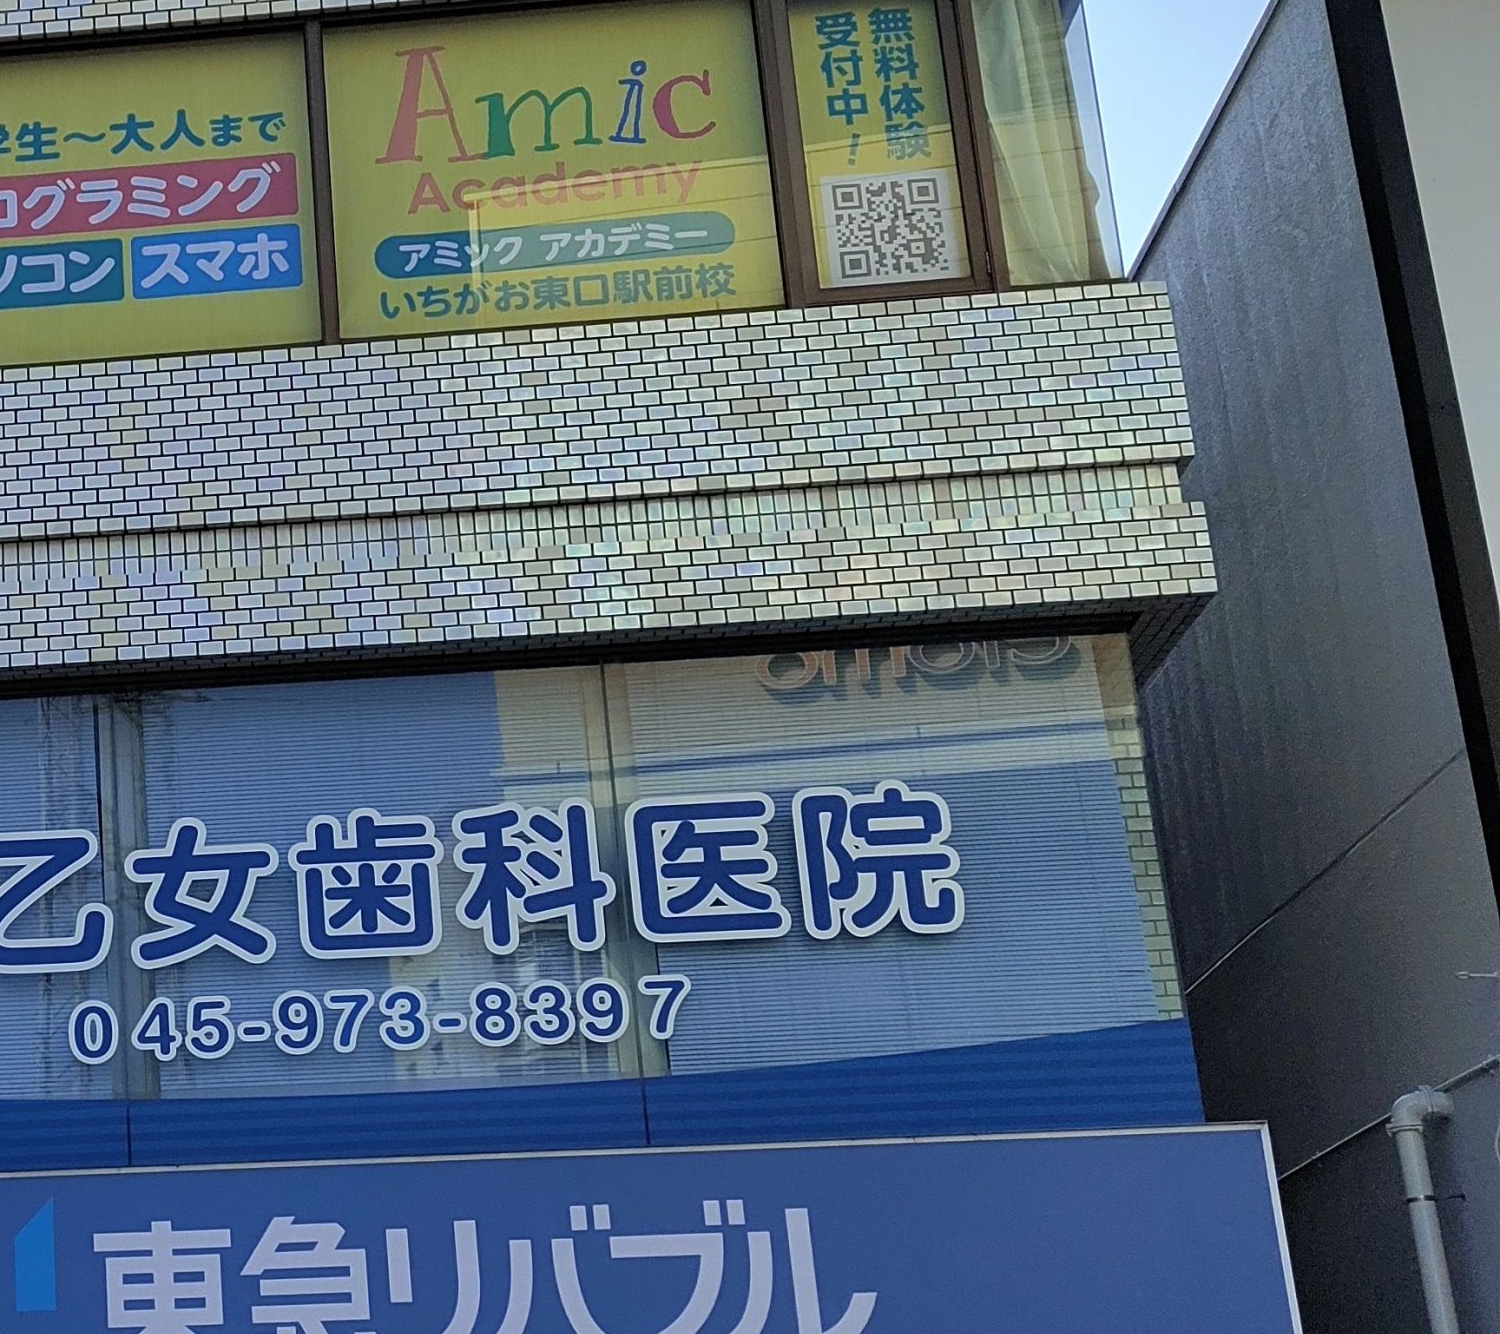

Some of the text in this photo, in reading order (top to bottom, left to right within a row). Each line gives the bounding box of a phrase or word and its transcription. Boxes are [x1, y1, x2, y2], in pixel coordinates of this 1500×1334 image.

[375, 45, 717, 167] Amic
[816, 12, 869, 168] 受付中！
[868, 7, 932, 161] 無料体験
[407, 161, 701, 215] Academy
[139, 232, 290, 288] スマホ
[398, 223, 708, 273] アミック アカデミー
[380, 261, 737, 321] いちがお東口駅前校
[69, 973, 692, 1065] 045-973-8397
